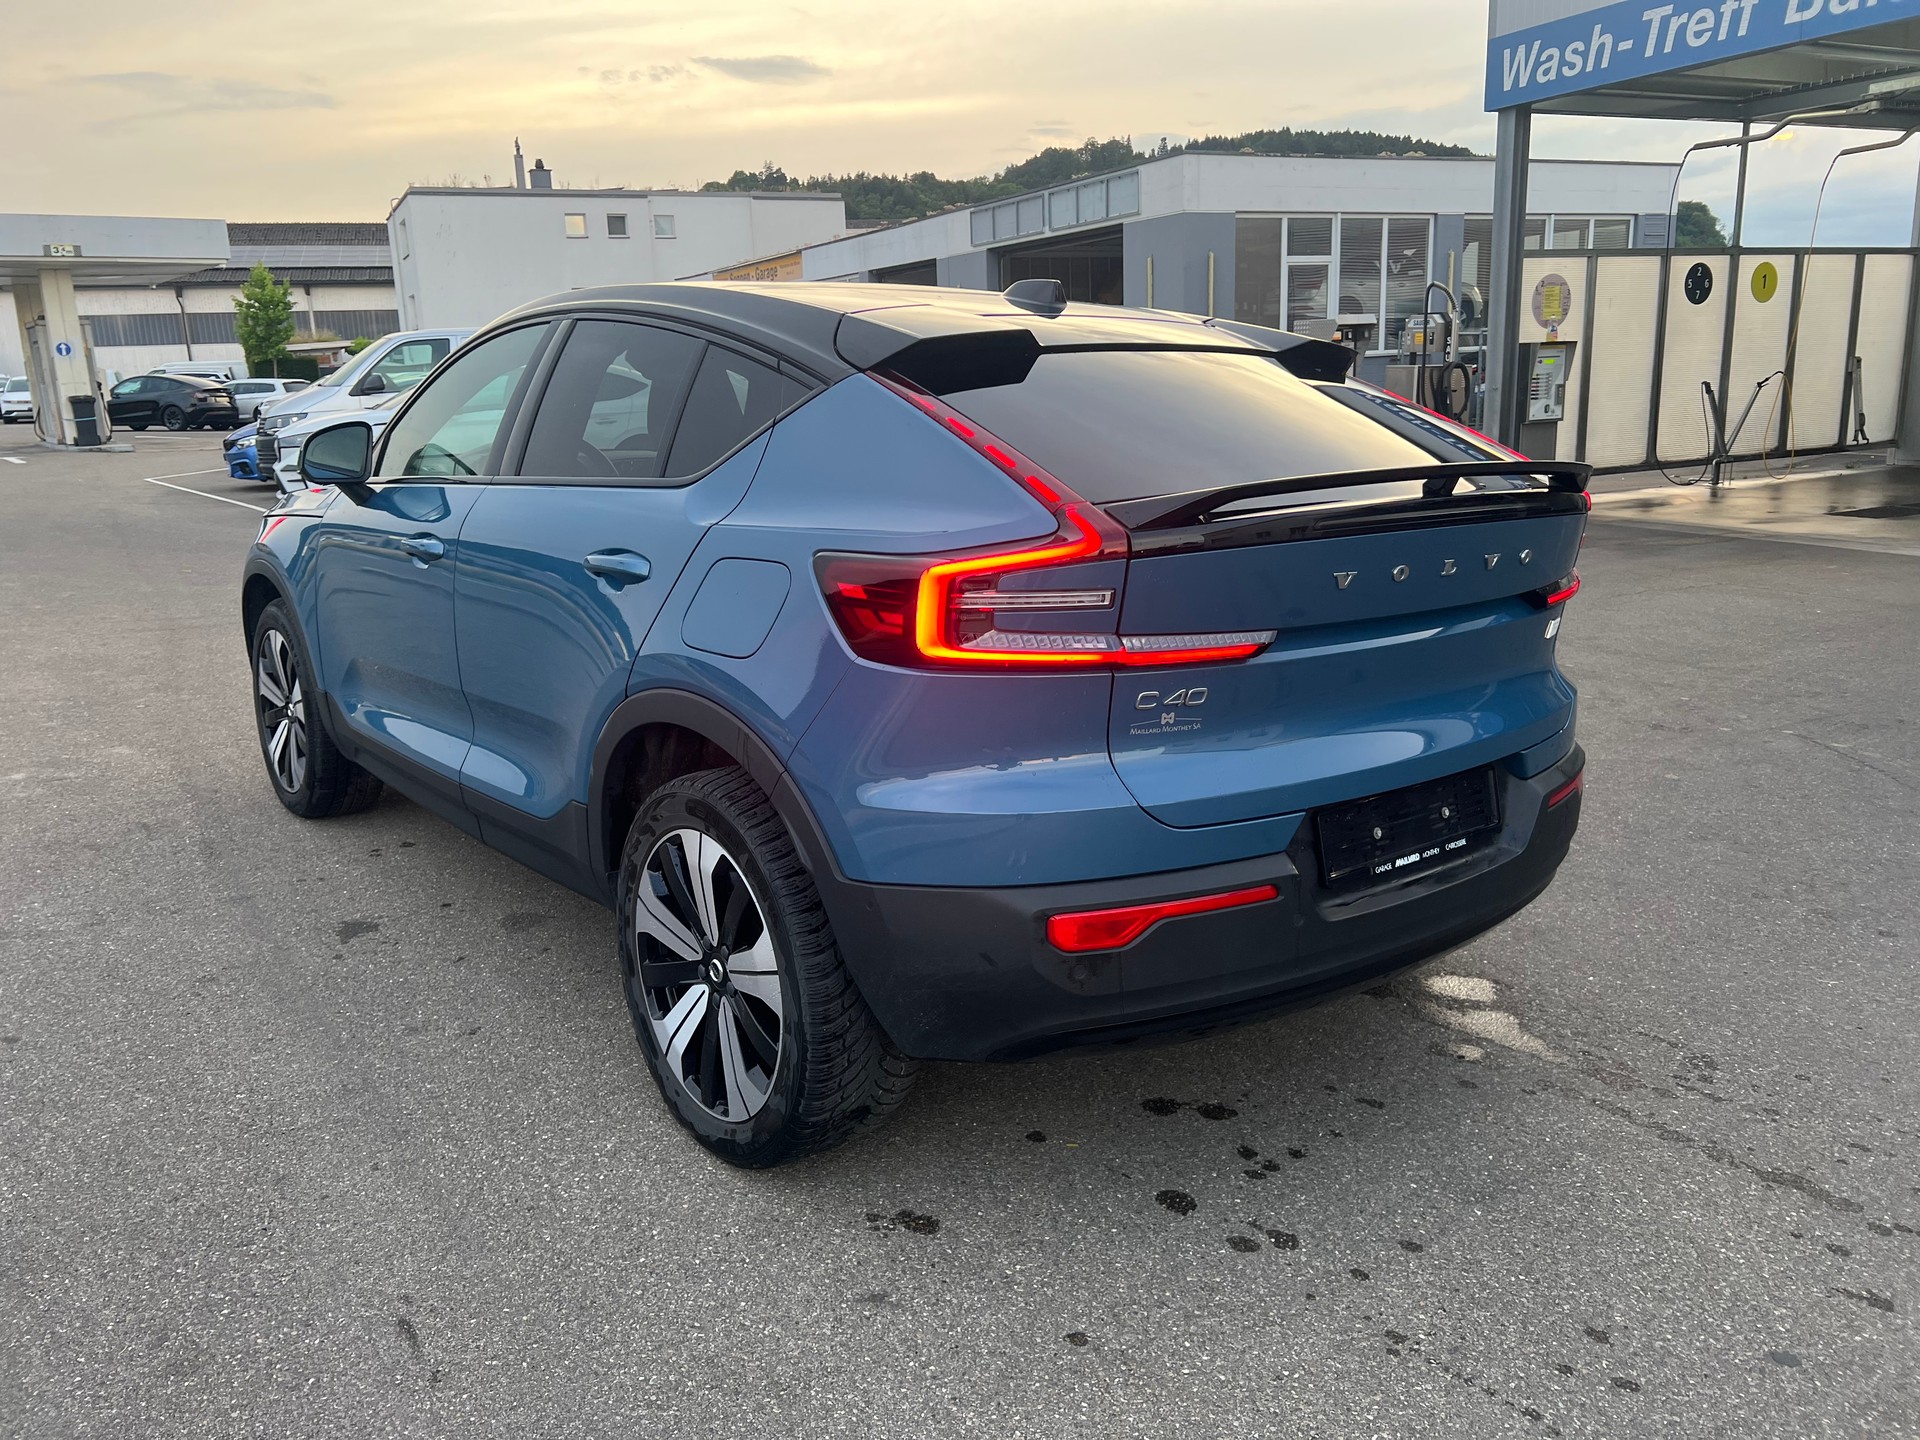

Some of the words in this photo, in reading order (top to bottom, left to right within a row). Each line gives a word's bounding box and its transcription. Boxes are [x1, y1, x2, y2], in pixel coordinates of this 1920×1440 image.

[1503, 0, 1758, 92] Wash-Treff
[755, 266, 778, 280] Garage
[1697, 267, 1702, 276] 2
[1687, 278, 1693, 289] 5
[1704, 278, 1710, 288] 6
[1762, 273, 1767, 289] 1
[1695, 290, 1701, 300] 7
[1333, 549, 1533, 590] VOLVO
[1193, 722, 1201, 730] SA
[1375, 862, 1393, 874] GARAGE
